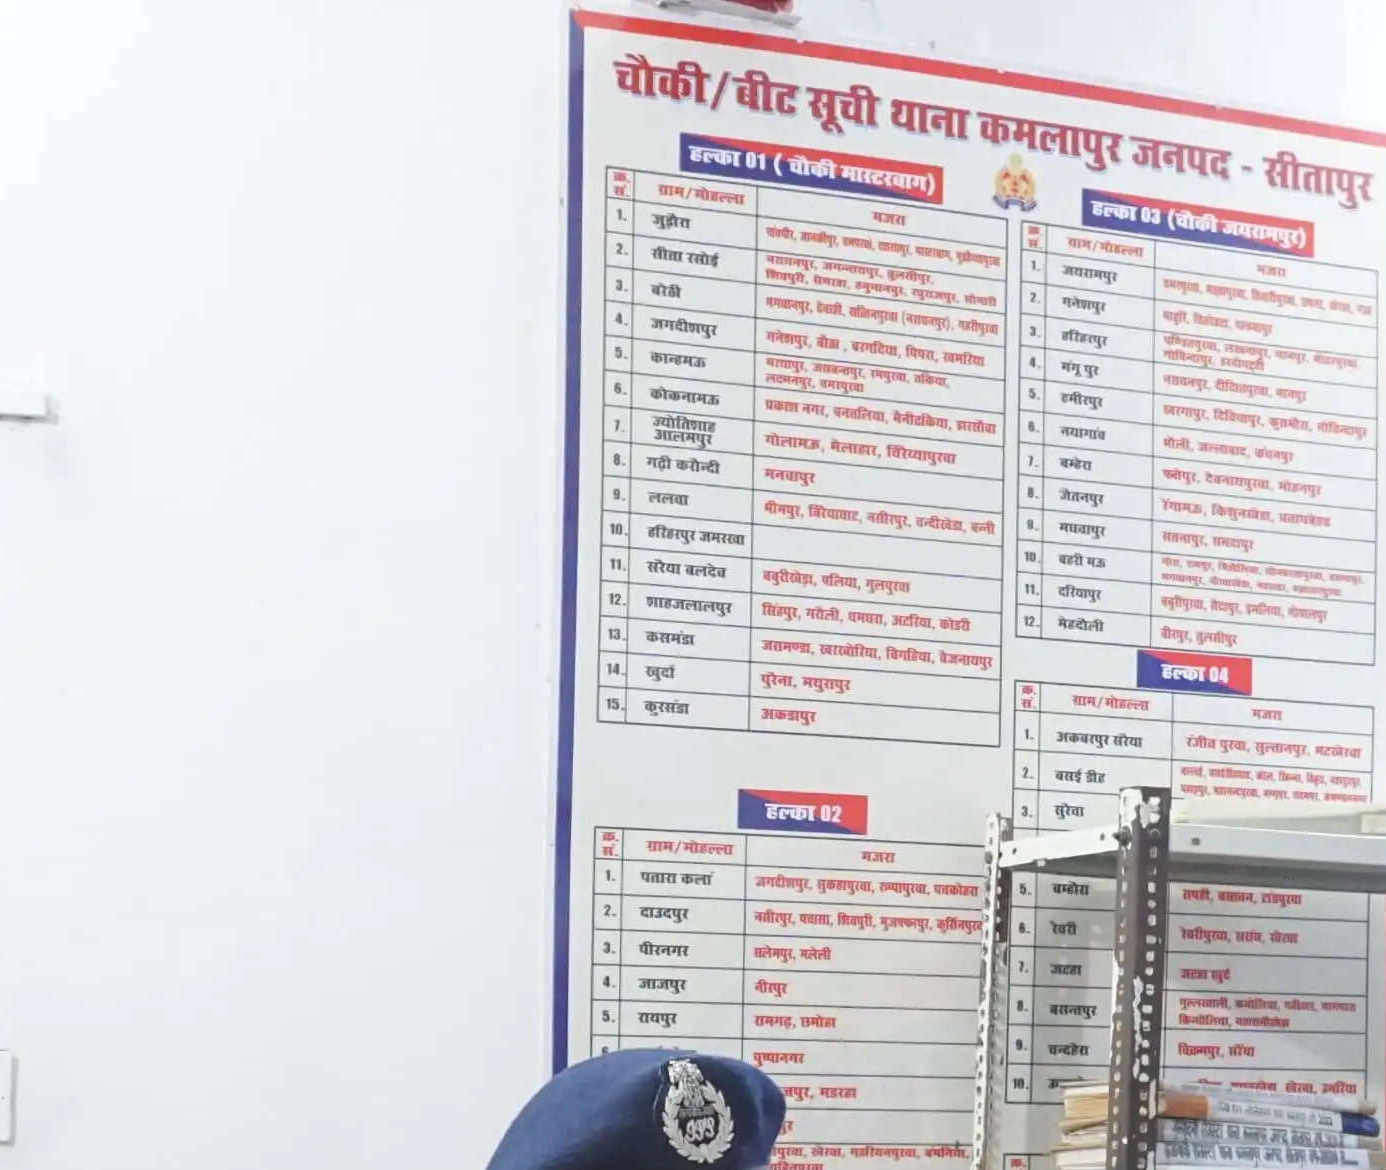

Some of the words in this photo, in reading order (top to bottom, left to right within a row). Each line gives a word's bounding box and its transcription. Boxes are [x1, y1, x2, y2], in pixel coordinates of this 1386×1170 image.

[613, 52, 800, 115] चौकी/बीट
[806, 84, 881, 134] सूची
[891, 99, 968, 140] थाना
[980, 111, 1123, 172] कमलापुर
[1131, 136, 1231, 180] जनपद
[1263, 150, 1374, 209] सीतापुर
[688, 143, 740, 168] हल्का
[745, 151, 765, 172] 01
[788, 154, 837, 180] चौकी
[617, 209, 627, 221] 1.
[872, 211, 905, 226] मजरा
[1091, 199, 1136, 220] हल्का
[1140, 206, 1161, 225] 03
[616, 243, 629, 256] 2.
[651, 246, 682, 262] सीता
[687, 253, 720, 268] रसोई
[1031, 260, 1041, 272] 1.
[1062, 264, 1117, 285] जयरामपुर
[615, 279, 628, 292] 3.
[1030, 293, 1041, 304] 2.
[1062, 296, 1106, 315] गनेशपुर
[615, 313, 628, 326] 4.
[651, 317, 717, 338] जगदीशपुर
[1030, 327, 1041, 338] 3.
[614, 347, 628, 359] 5.
[1029, 357, 1041, 368] 4.
[1084, 364, 1099, 378] पुर
[614, 383, 627, 395] 6.
[1028, 388, 1041, 400] 5.
[650, 386, 721, 406] कोकनामऊ
[1061, 392, 1103, 410] हमीरपुर
[614, 420, 625, 433] 7.
[652, 415, 716, 432] ज्योतिशाह
[1028, 421, 1039, 433] 6.
[654, 429, 712, 449] आलमपुर
[614, 453, 626, 466] 8.
[647, 456, 670, 472] गढ़ी
[1028, 456, 1039, 468] 7.
[613, 488, 626, 501] 9.
[1028, 487, 1039, 499] 8.
[610, 523, 629, 536] 10.
[1027, 519, 1038, 531] 9.
[647, 523, 695, 545] हरिहरपुर
[1025, 551, 1041, 563] 10.
[610, 558, 626, 571] 11.
[1025, 583, 1039, 596] 11.
[1058, 586, 1102, 603] दरियापुर
[609, 592, 626, 606] 12.
[646, 596, 733, 616] शाहजलालपुर
[1024, 616, 1040, 628] 12.
[608, 628, 626, 640] 13.
[645, 629, 695, 646] कसमंडा
[607, 663, 626, 676] 14.
[1161, 664, 1206, 682] हल्का
[1209, 667, 1229, 683] 04
[606, 698, 626, 711] 15.
[644, 699, 690, 717] कुरसंडा
[1252, 708, 1283, 721] मजरा
[1024, 728, 1034, 740] 1.
[1056, 731, 1109, 748] अकबरपुर
[1022, 767, 1033, 779] 2.
[1085, 770, 1106, 783] डीह
[765, 803, 815, 821] हल्का
[820, 804, 842, 823] 02
[1021, 806, 1033, 818] 3.
[646, 839, 735, 856] ग्राम/मोहल्ला
[861, 851, 896, 864] मजरा
[605, 870, 616, 882] 1.
[640, 870, 677, 885] पतारा
[1019, 883, 1032, 896] 5.
[604, 904, 616, 918] 2.
[639, 906, 689, 924] दाउदपुर
[1019, 923, 1031, 934] 6.
[603, 942, 616, 954] 3.
[639, 941, 689, 959] पीरनगर
[1018, 961, 1029, 974] 7.
[602, 976, 616, 989] 4.
[638, 977, 687, 995] जाजपुर
[602, 1010, 616, 1023] 5.
[1050, 1004, 1098, 1019] बसन्तपुर
[638, 1010, 678, 1029] रायपुर
[1013, 1077, 1029, 1090] 10.
